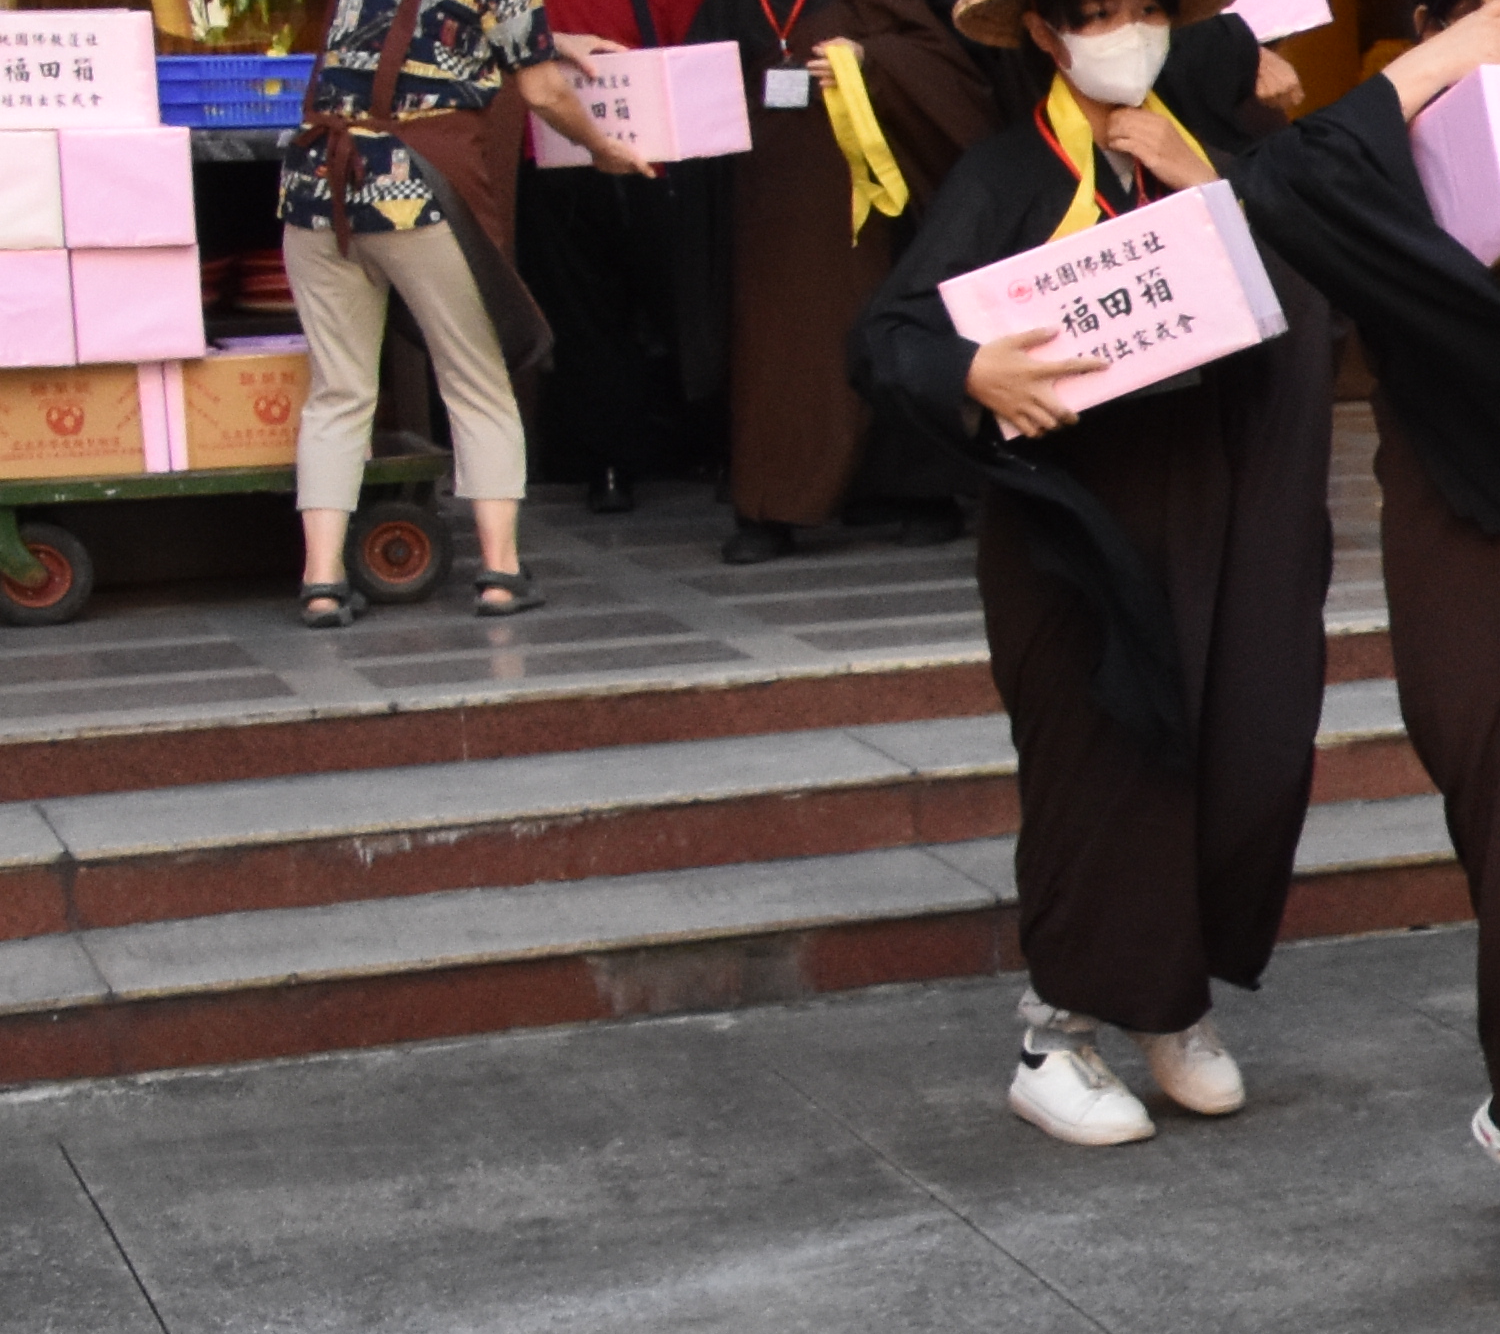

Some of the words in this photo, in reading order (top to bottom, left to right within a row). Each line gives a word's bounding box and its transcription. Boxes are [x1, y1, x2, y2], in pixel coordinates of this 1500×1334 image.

[4, 58, 94, 82] 福田箱
[1034, 231, 1166, 295] 桃園佛教蓮社
[1060, 267, 1174, 338] 福田箱
[1072, 312, 1197, 366] 期出家戒會
